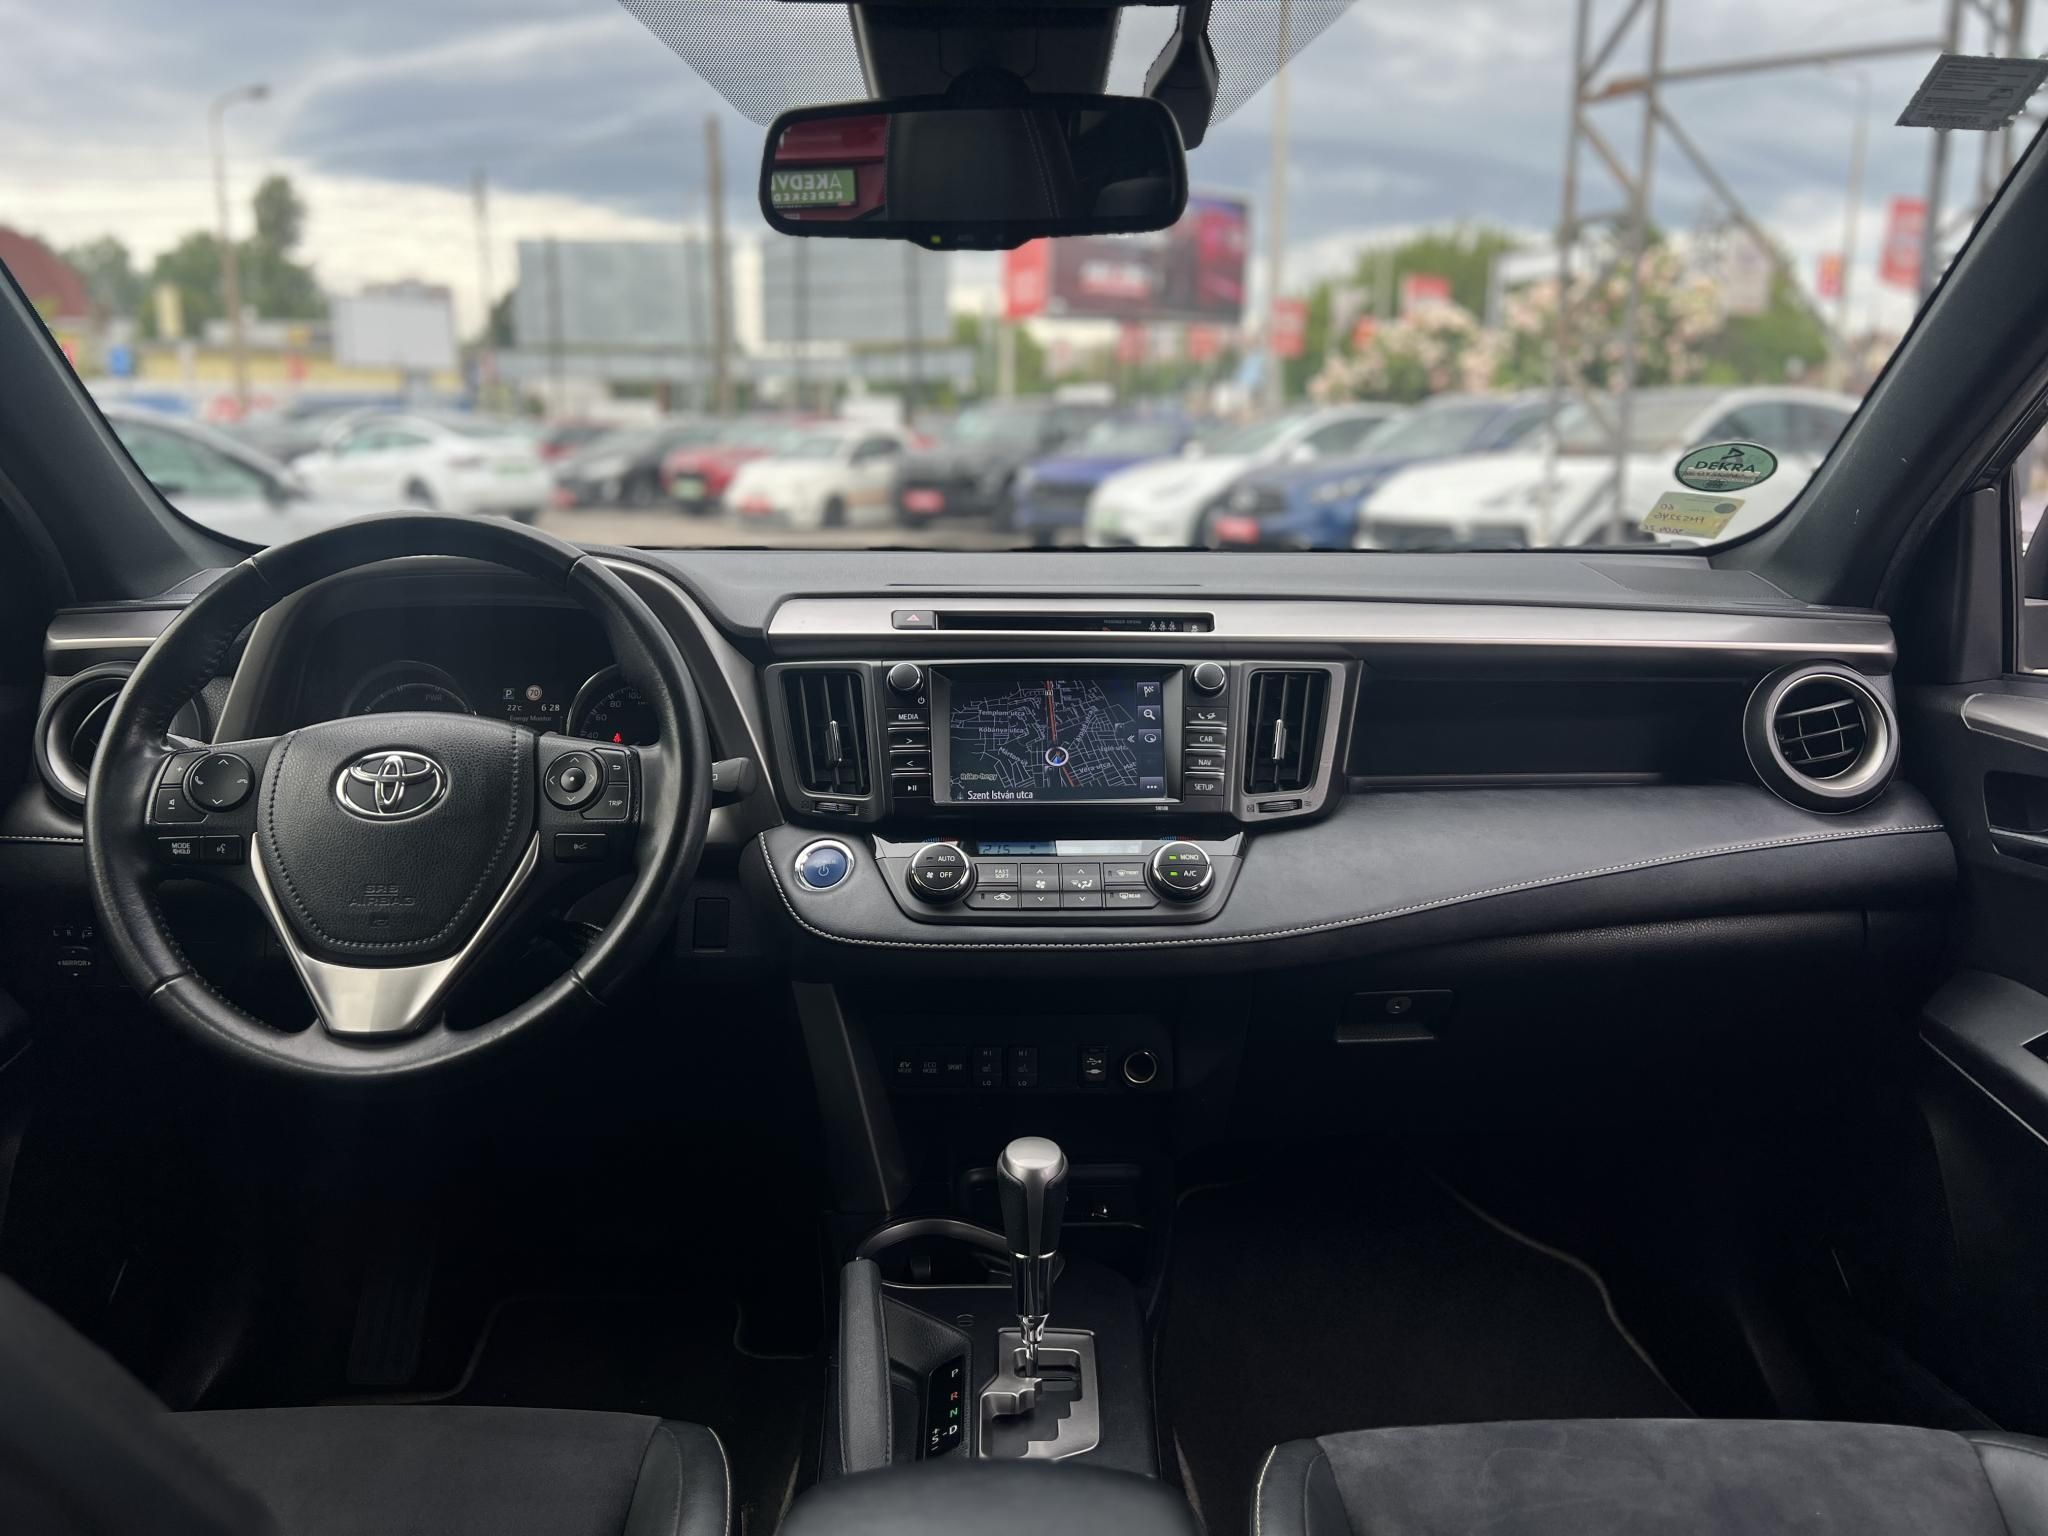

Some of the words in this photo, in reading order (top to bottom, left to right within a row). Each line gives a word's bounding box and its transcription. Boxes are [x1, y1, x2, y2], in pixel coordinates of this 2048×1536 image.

[1694, 461, 1755, 473] DEKRA
[510, 714, 529, 723] Energy
[530, 714, 552, 722] Monitor
[978, 710, 1009, 718] Templom
[1198, 758, 1212, 766] NAV
[1194, 783, 1214, 792] SETUP
[967, 790, 991, 800] Szent
[992, 790, 1015, 800] István
[1016, 791, 1034, 800] utca
[951, 1368, 958, 1377] P
[951, 1392, 958, 1400] R
[950, 1408, 957, 1417] N
[949, 1425, 957, 1434] D
[932, 1435, 939, 1443] S
